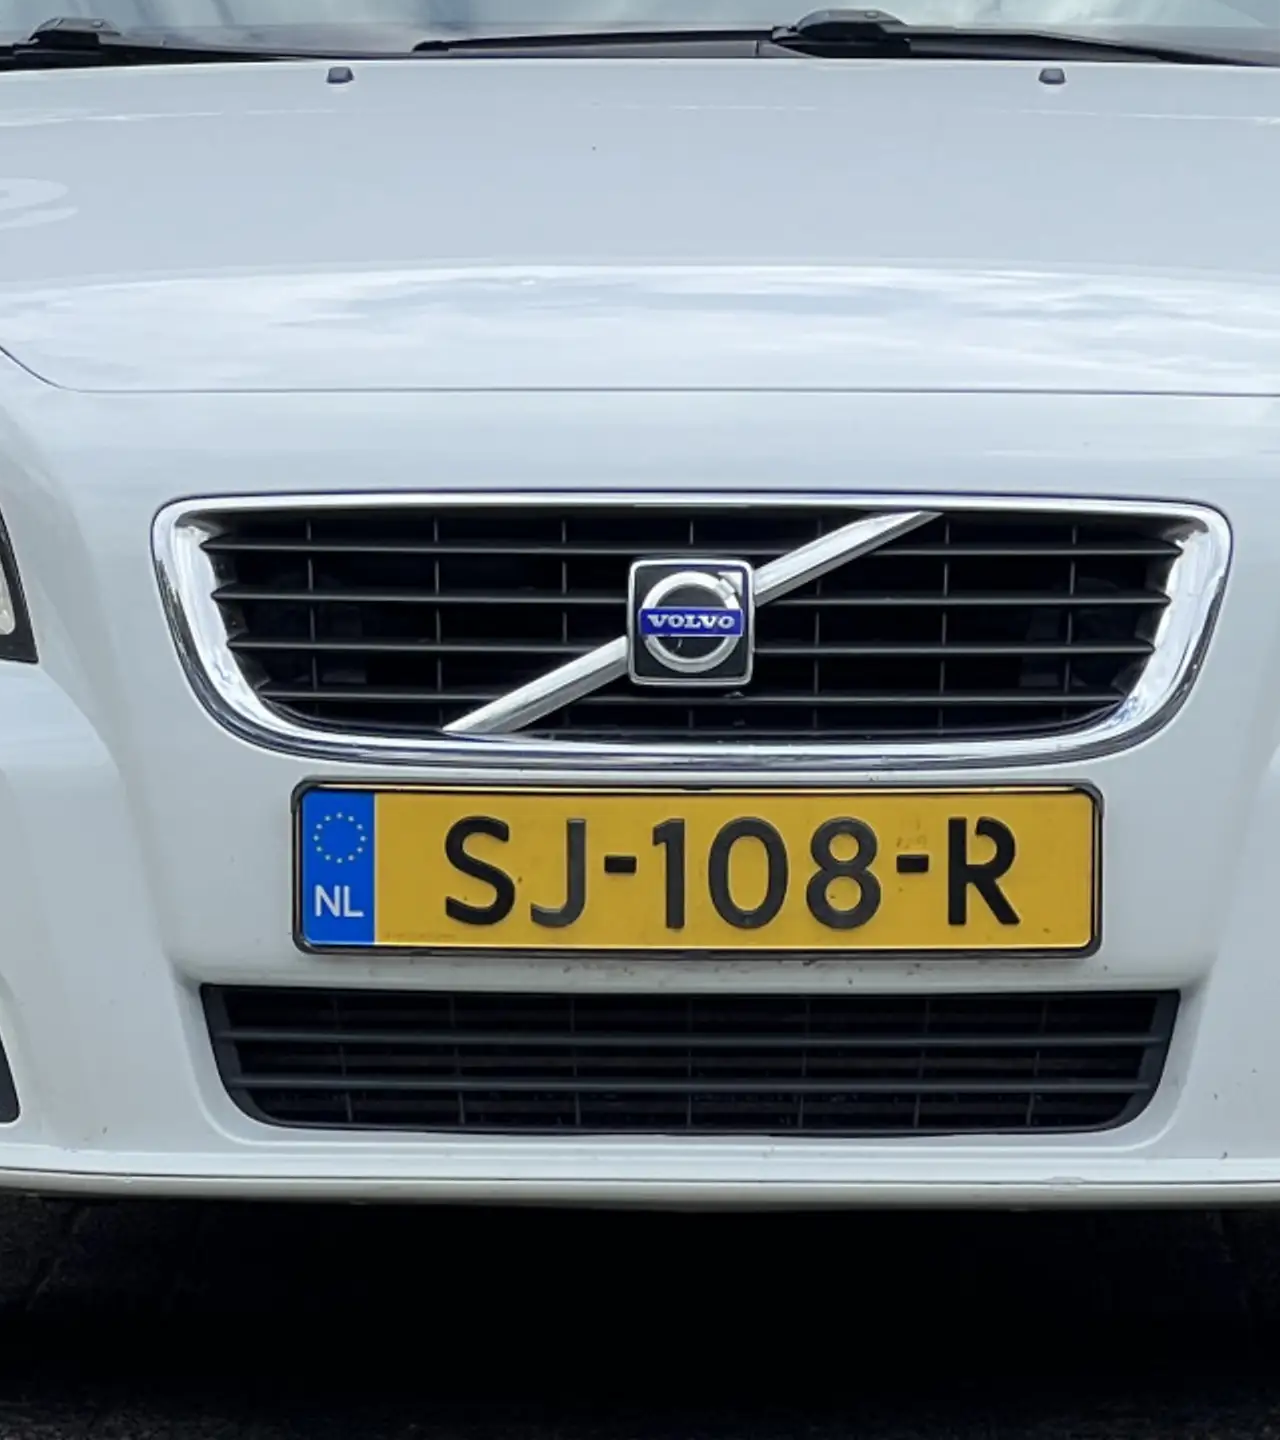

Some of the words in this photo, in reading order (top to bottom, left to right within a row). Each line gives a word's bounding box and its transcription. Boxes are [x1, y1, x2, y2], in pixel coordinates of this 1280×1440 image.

[647, 614, 735, 629] VOLVO
[316, 886, 364, 917] NL
[445, 817, 1019, 929] SJ-108-R
